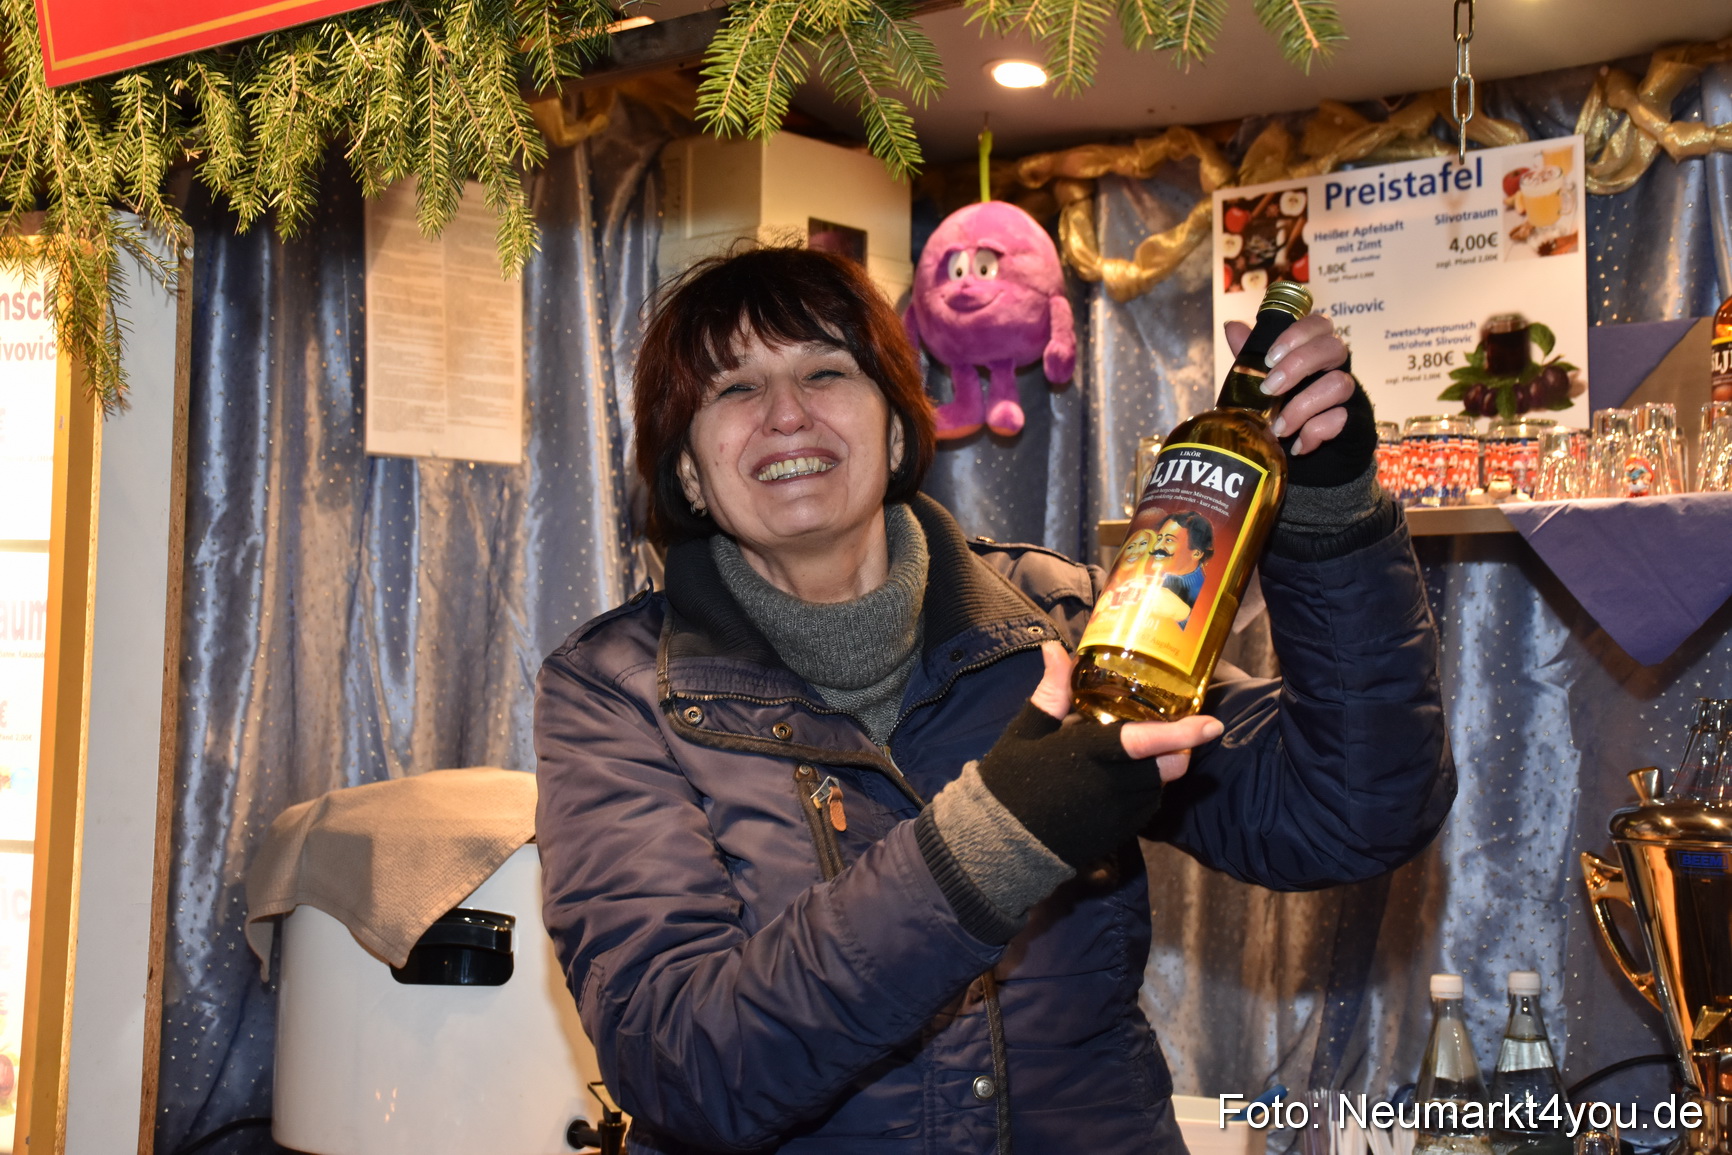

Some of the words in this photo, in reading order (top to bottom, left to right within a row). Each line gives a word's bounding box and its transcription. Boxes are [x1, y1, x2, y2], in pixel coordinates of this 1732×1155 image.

[1325, 156, 1482, 211] Preistafel
[1435, 208, 1498, 225] Slivotraum
[1314, 227, 1349, 242] Heißer
[1353, 220, 1404, 238] Apfelsaft
[1336, 243, 1353, 254] mit
[1357, 239, 1382, 251] Zimt
[1449, 231, 1498, 254] 4,00€
[1318, 262, 1347, 276] 1,80€
[1454, 255, 1477, 265] Pfand
[1330, 297, 1385, 318] Slivovic
[1384, 321, 1477, 339] Zwetschgenpunsch
[1388, 339, 1433, 352] mit/ohne
[1436, 333, 1472, 347] Slivovic
[1407, 350, 1454, 371] 3,80€
[1179, 450, 1202, 458] LIKÖR
[1152, 637, 1181, 655] Augsburg
[1682, 854, 1723, 867] BEEM
